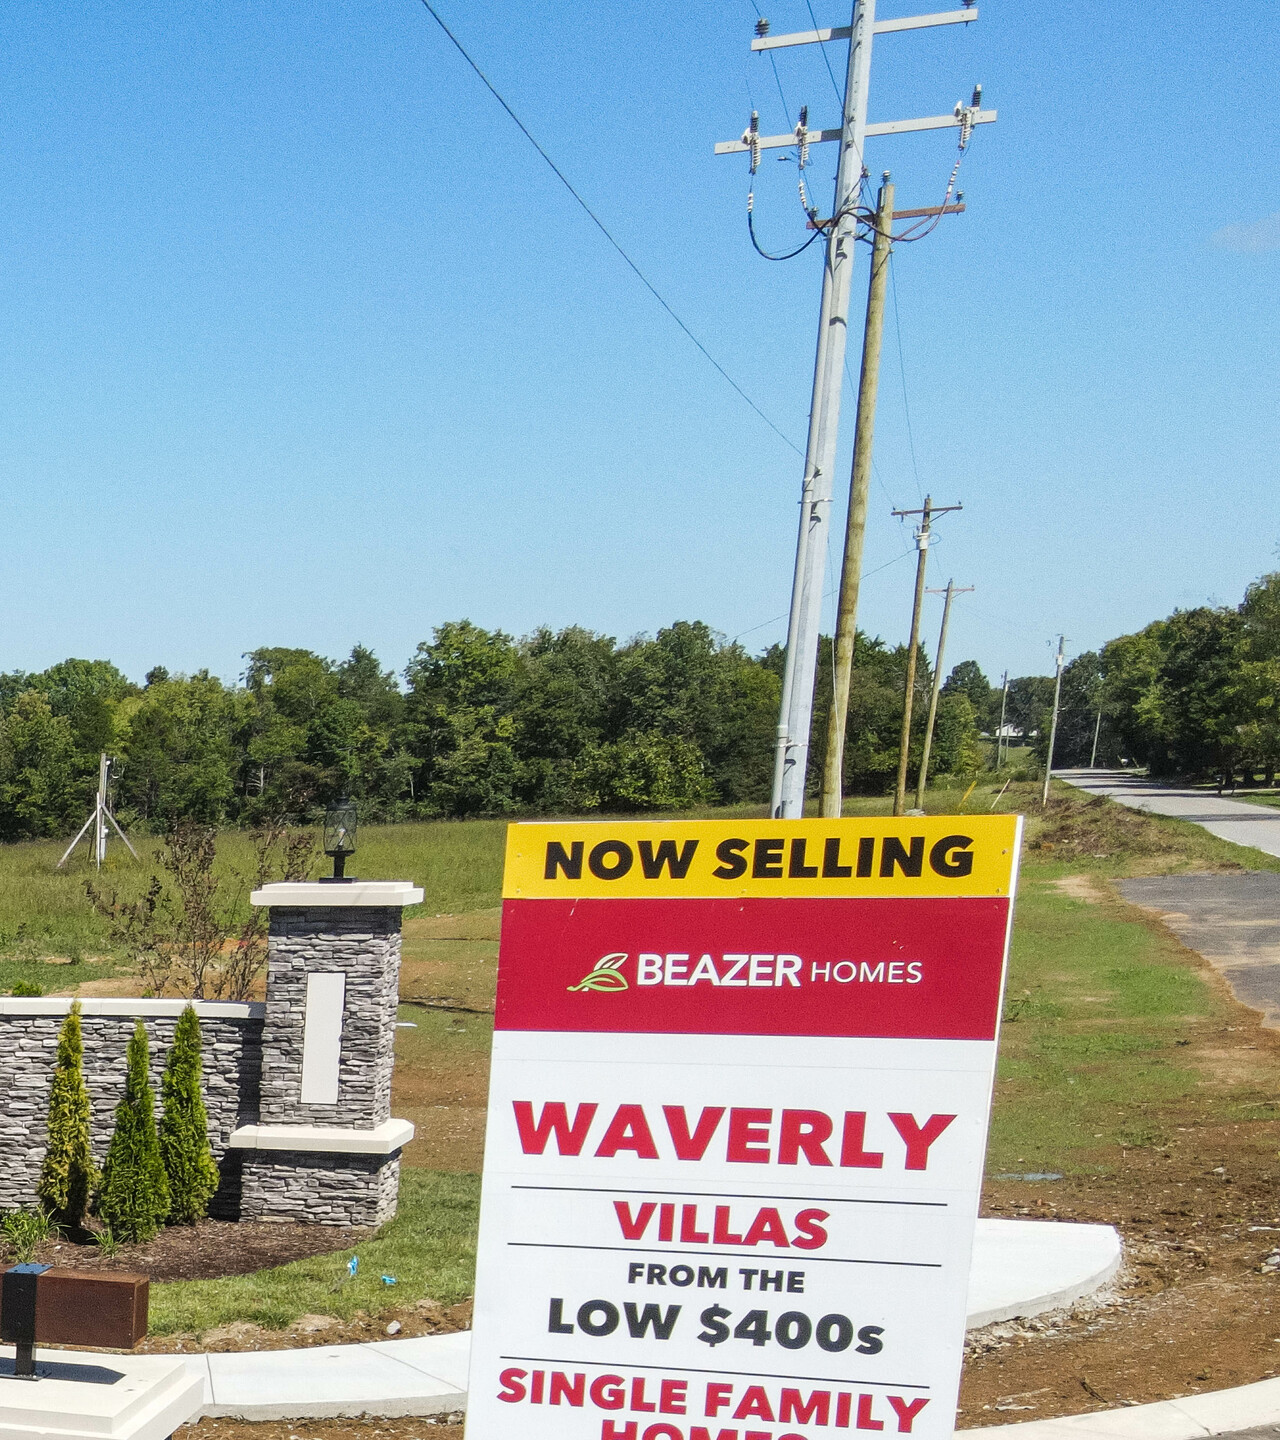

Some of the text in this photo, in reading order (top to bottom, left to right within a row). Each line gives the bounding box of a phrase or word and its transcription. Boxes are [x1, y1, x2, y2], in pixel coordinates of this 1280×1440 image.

[544, 834, 974, 881] NOW SELLING
[636, 953, 923, 987] BEAZER HOMES
[512, 1100, 958, 1171] WAVERLY
[613, 1200, 830, 1250] VILLAS
[628, 1262, 805, 1294] FROM THE
[548, 1297, 885, 1355] LOW $400s
[496, 1367, 931, 1434] SINGLE FAMILY
